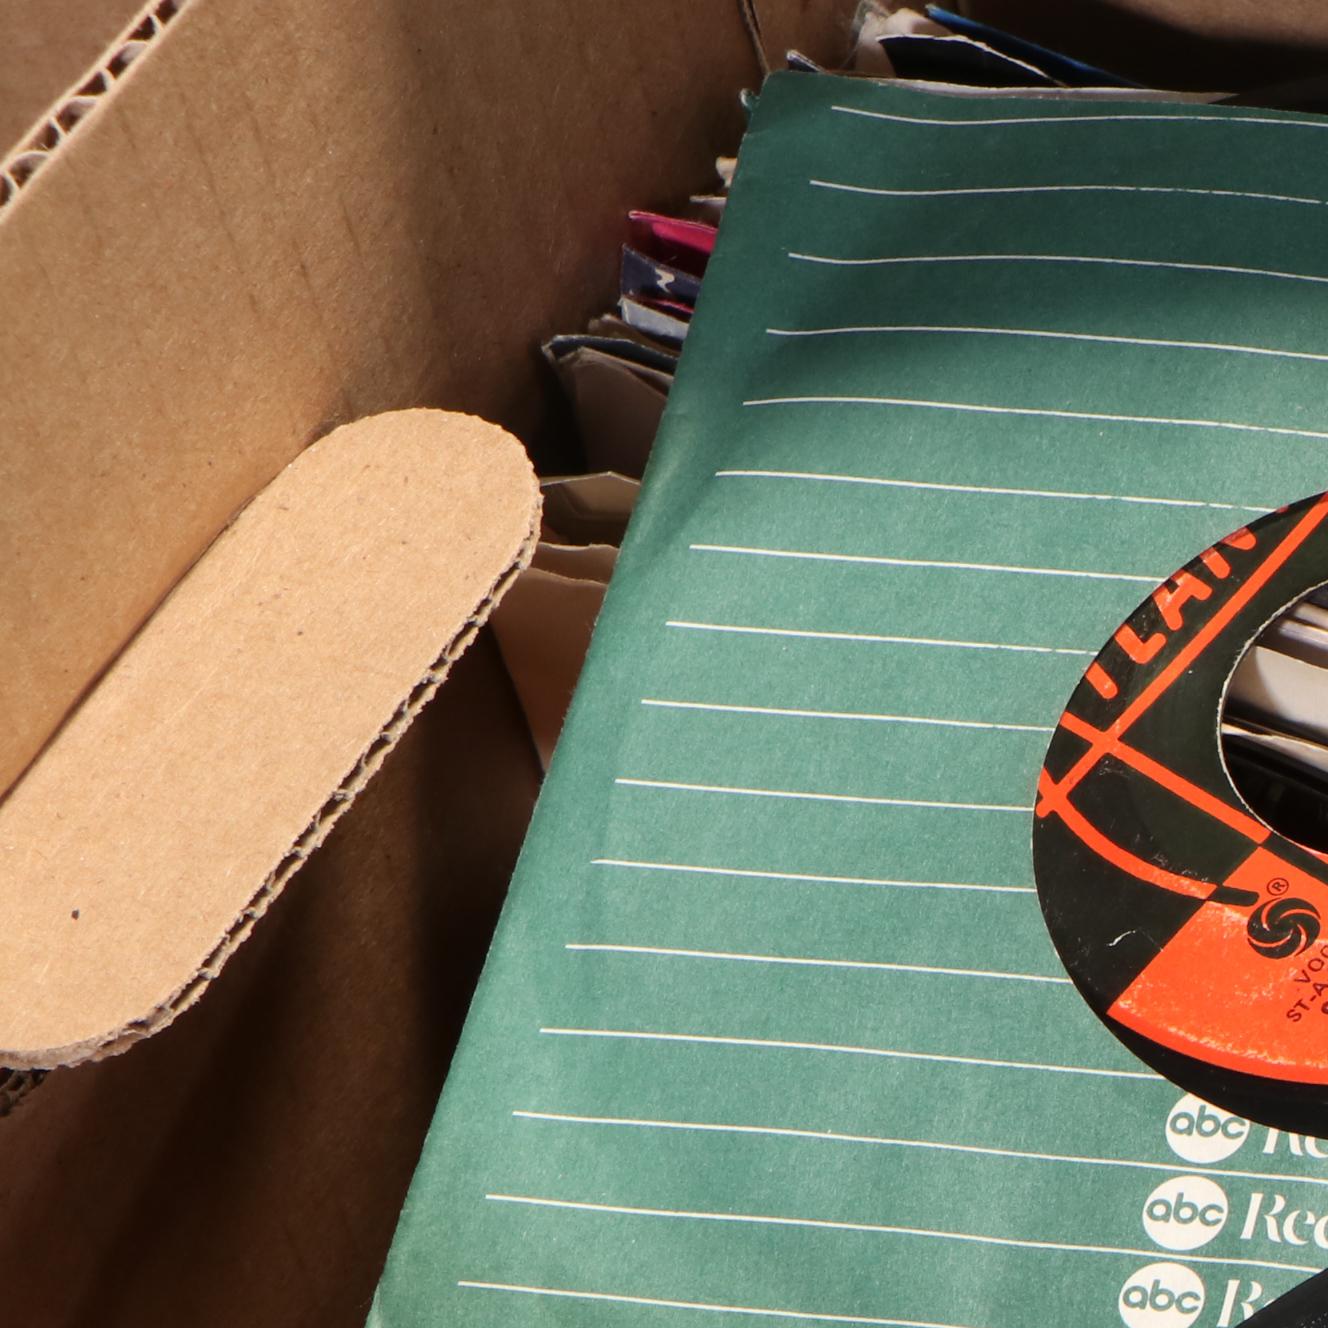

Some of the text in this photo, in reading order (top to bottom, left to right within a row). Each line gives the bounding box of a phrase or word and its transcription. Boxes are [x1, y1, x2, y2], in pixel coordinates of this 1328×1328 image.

[1169, 1105, 1246, 1140] abc
[1146, 1191, 1224, 1228] abc
[1122, 1279, 1201, 1315] abc
